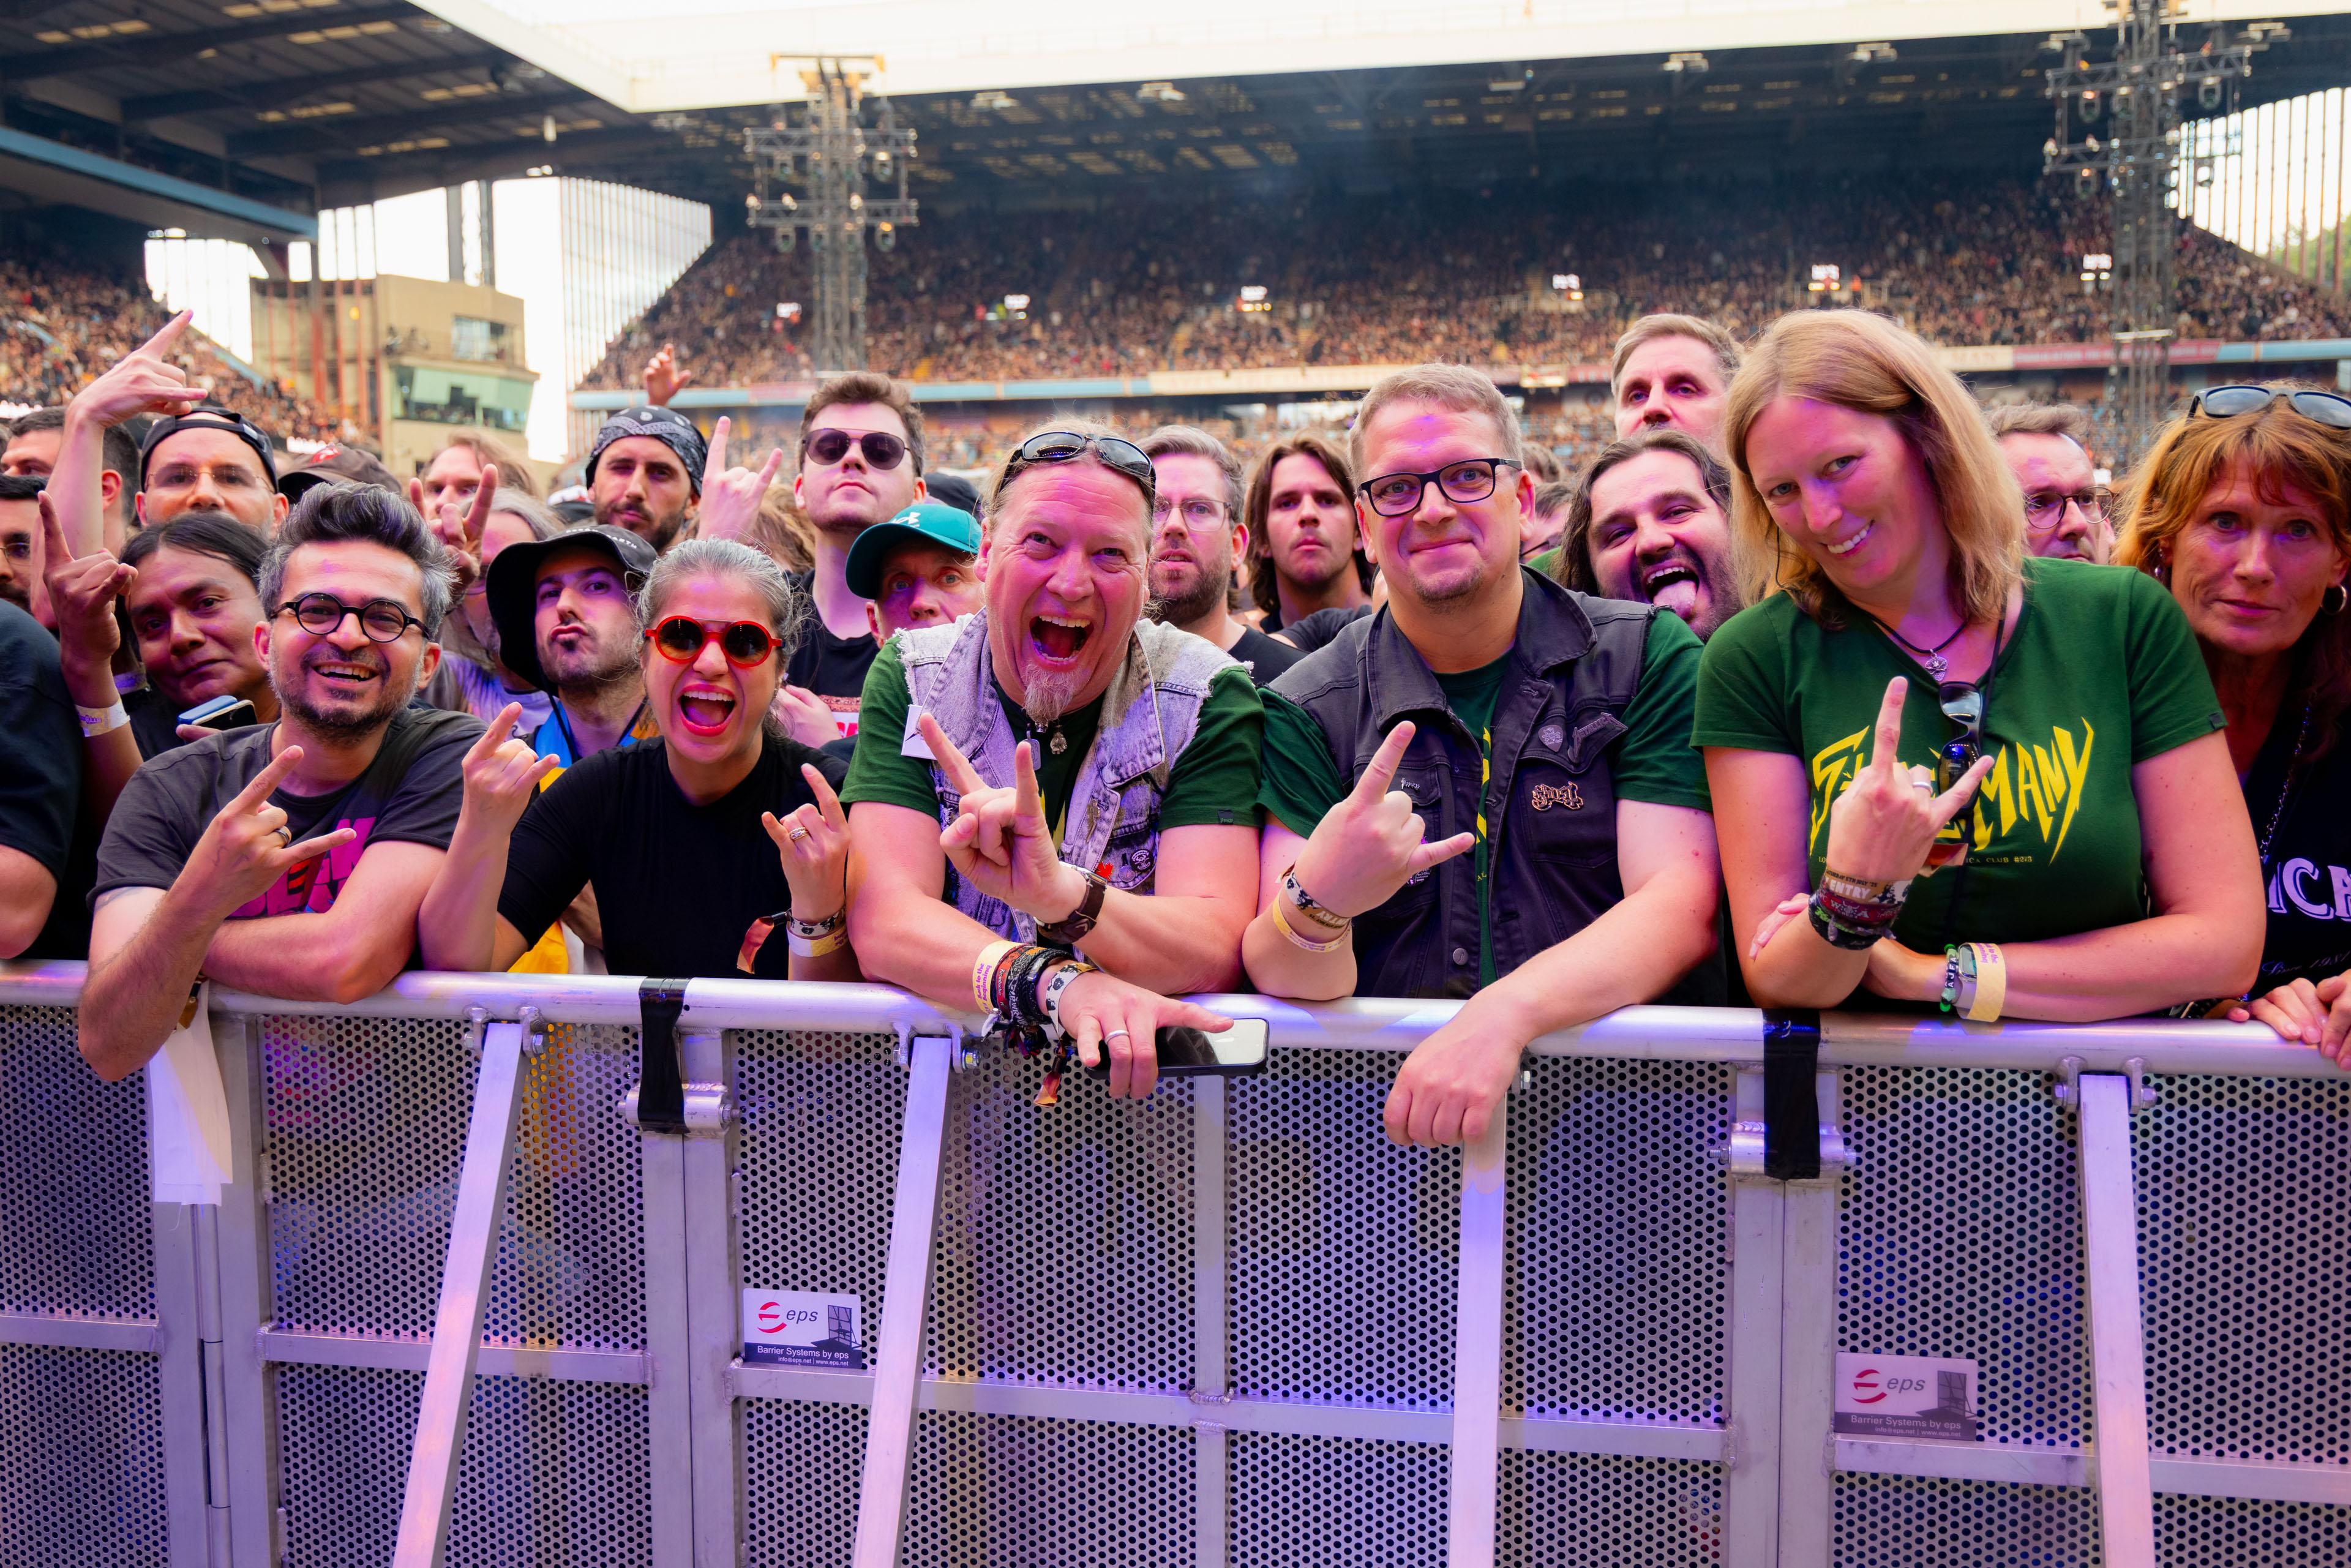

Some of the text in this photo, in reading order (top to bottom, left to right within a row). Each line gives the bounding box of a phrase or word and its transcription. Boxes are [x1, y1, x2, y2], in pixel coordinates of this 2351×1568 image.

[1809, 716, 2094, 865] GMANY
[1829, 879, 1870, 899] ENTRY
[981, 964, 992, 1002] Beginning
[786, 1309, 819, 1324] eps
[757, 1345, 849, 1360] Barrier Systems by eps
[1887, 1378, 1926, 1394] eps
[1851, 1415, 1961, 1430] Barrier Systems by eps
